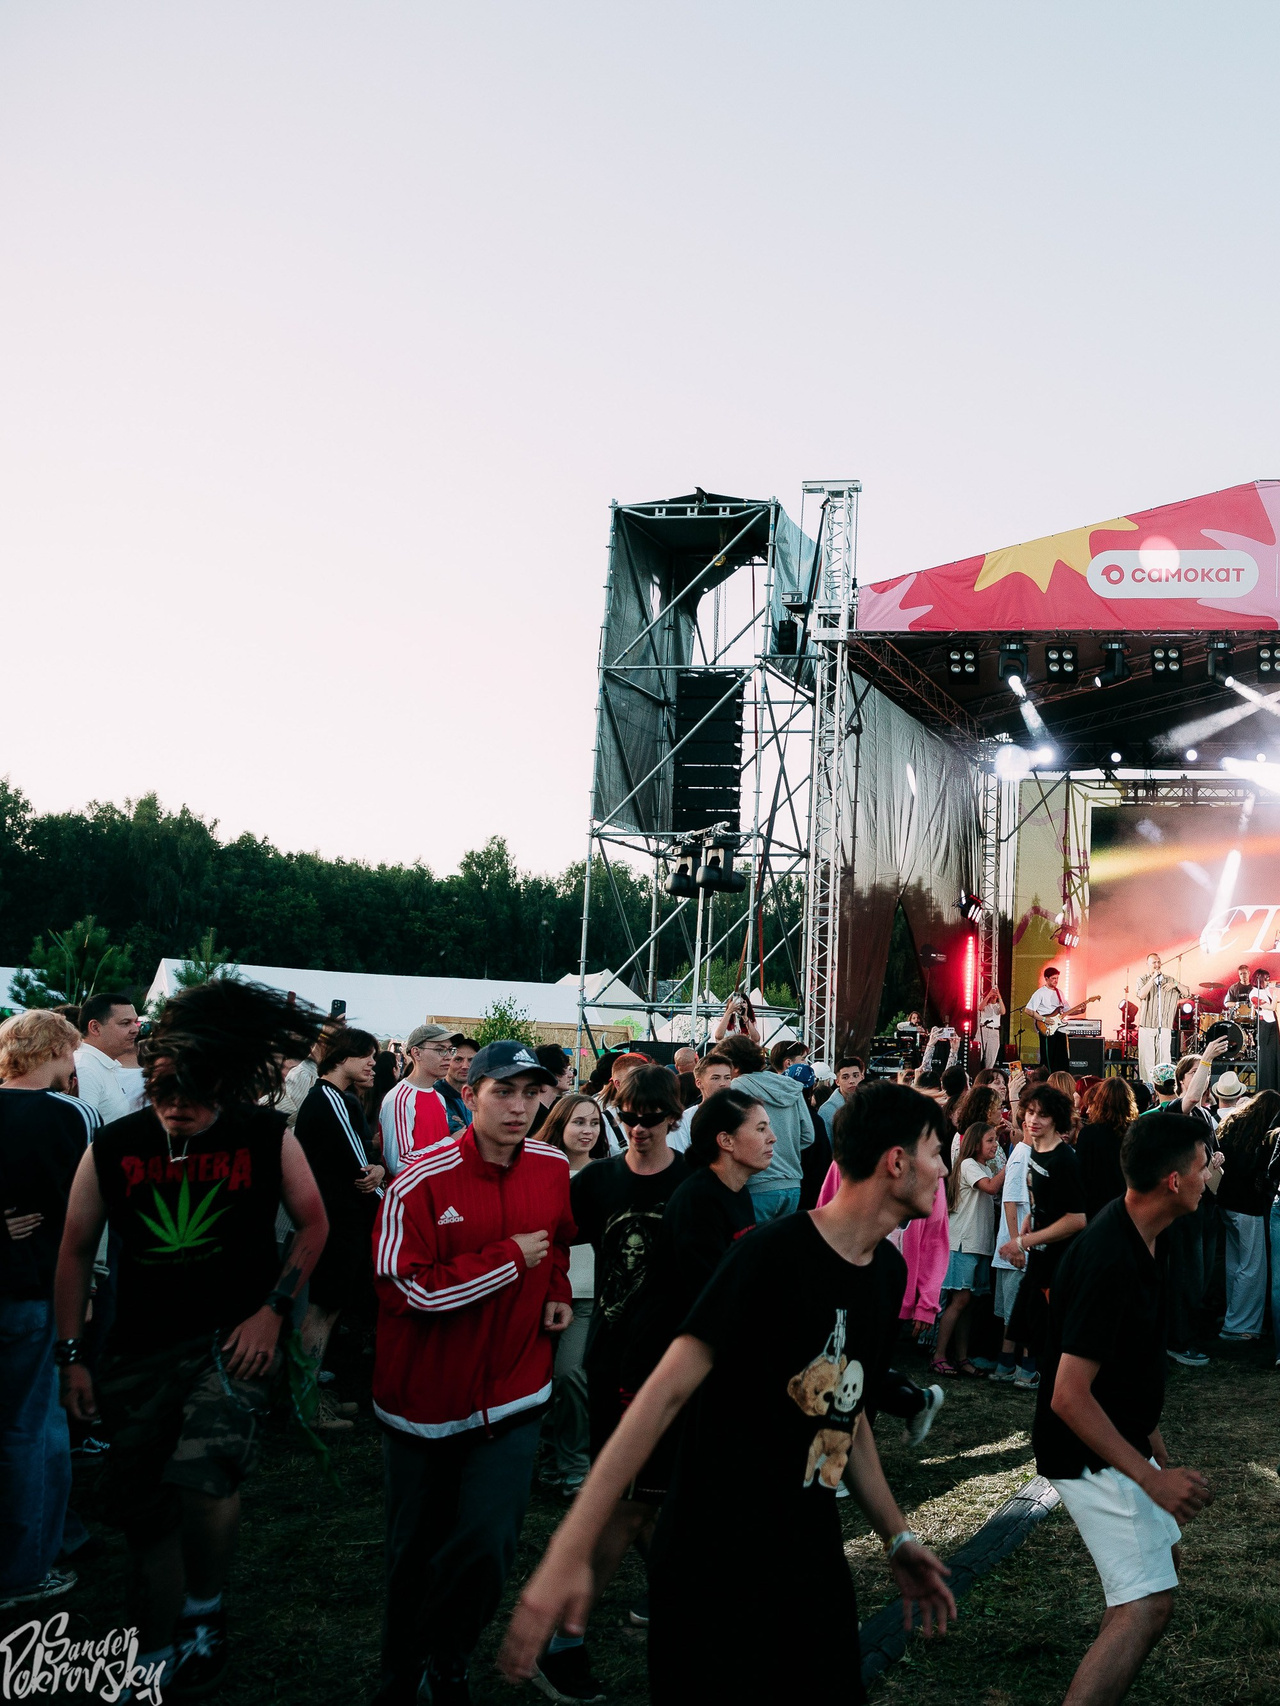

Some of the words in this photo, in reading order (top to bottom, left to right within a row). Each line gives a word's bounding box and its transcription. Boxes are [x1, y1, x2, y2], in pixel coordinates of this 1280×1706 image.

[1131, 566, 1245, 583] самокат
[120, 1147, 252, 1197] PANTERA
[437, 1215, 464, 1225] adidas
